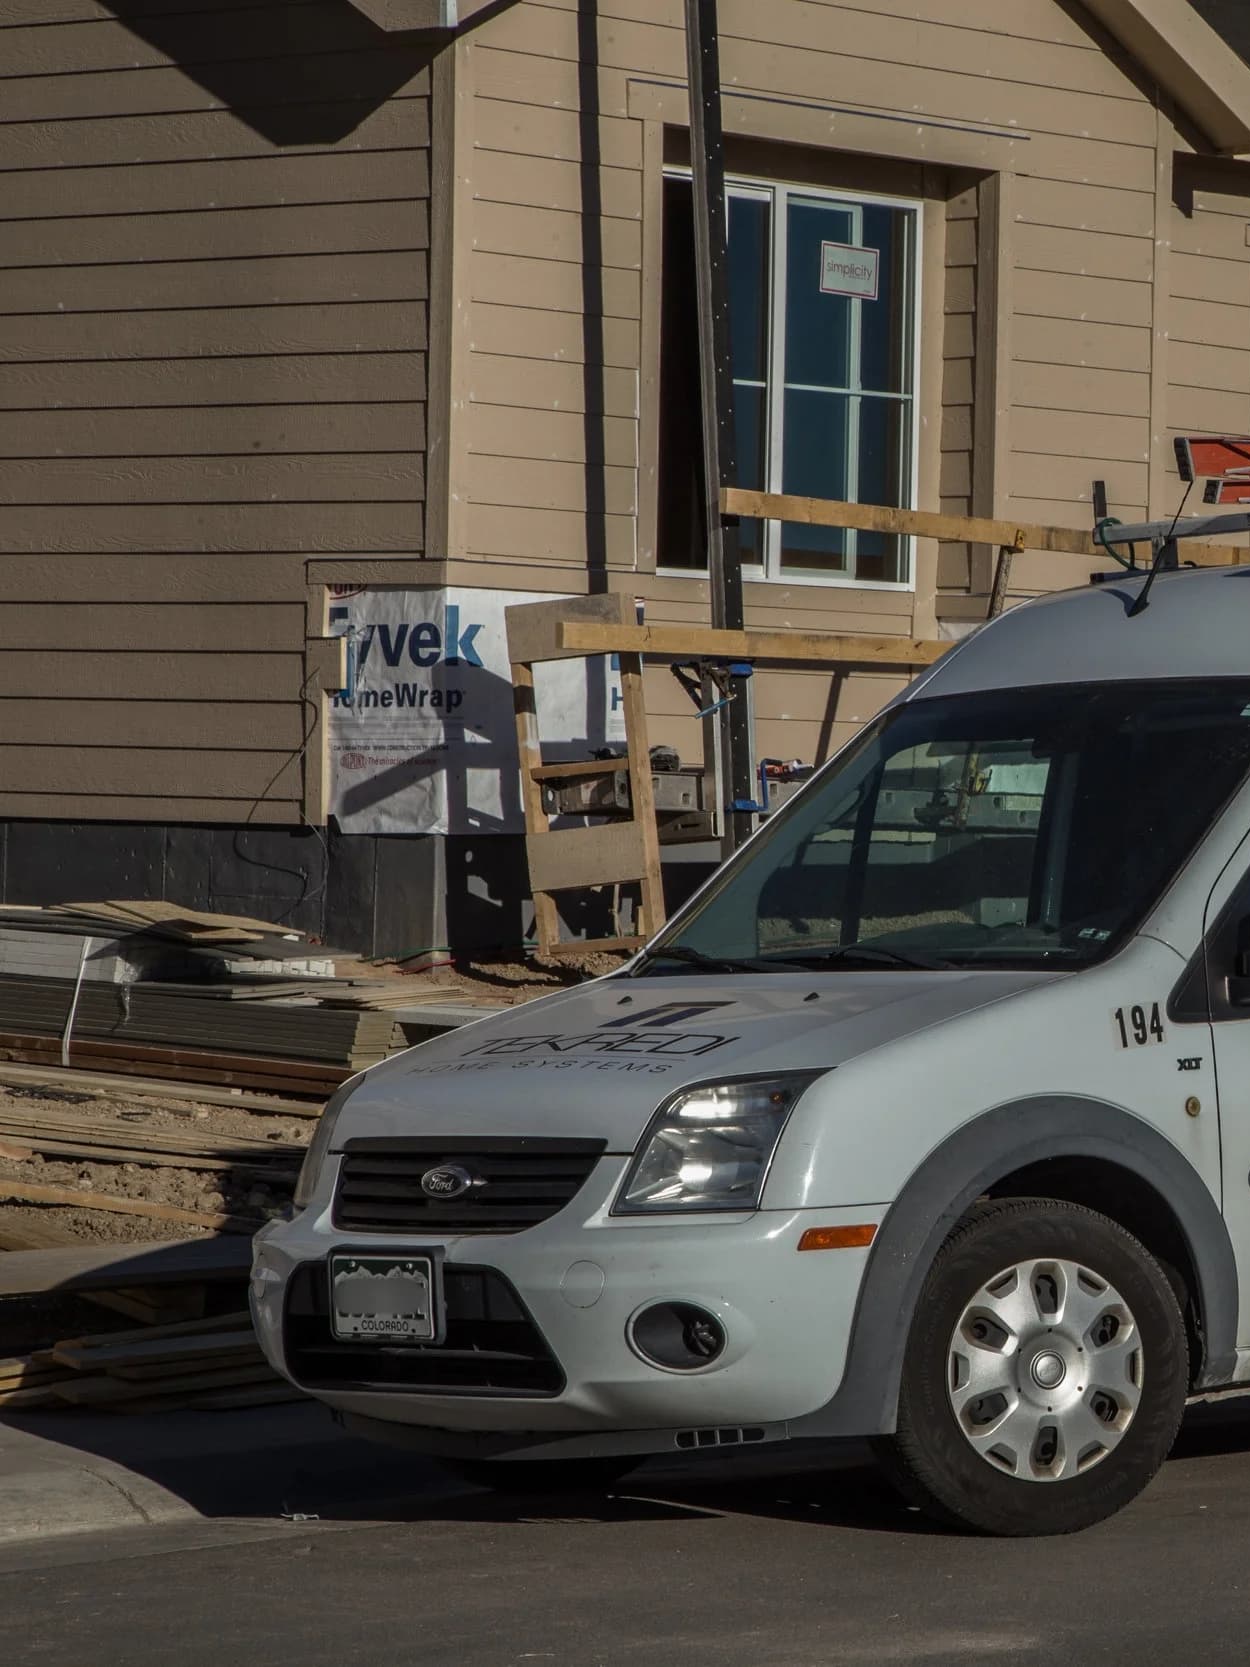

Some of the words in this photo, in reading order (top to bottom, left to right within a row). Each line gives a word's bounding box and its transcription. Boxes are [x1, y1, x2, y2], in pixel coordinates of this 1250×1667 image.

[826, 258, 872, 280] simplicity
[1115, 1002, 1163, 1048] 194
[460, 1033, 741, 1057] TEKREDI
[407, 1061, 500, 1074] HOME
[512, 1060, 673, 1074] SYSTEMS
[429, 1173, 454, 1192] Ford
[361, 1320, 409, 1332] COLORADO
